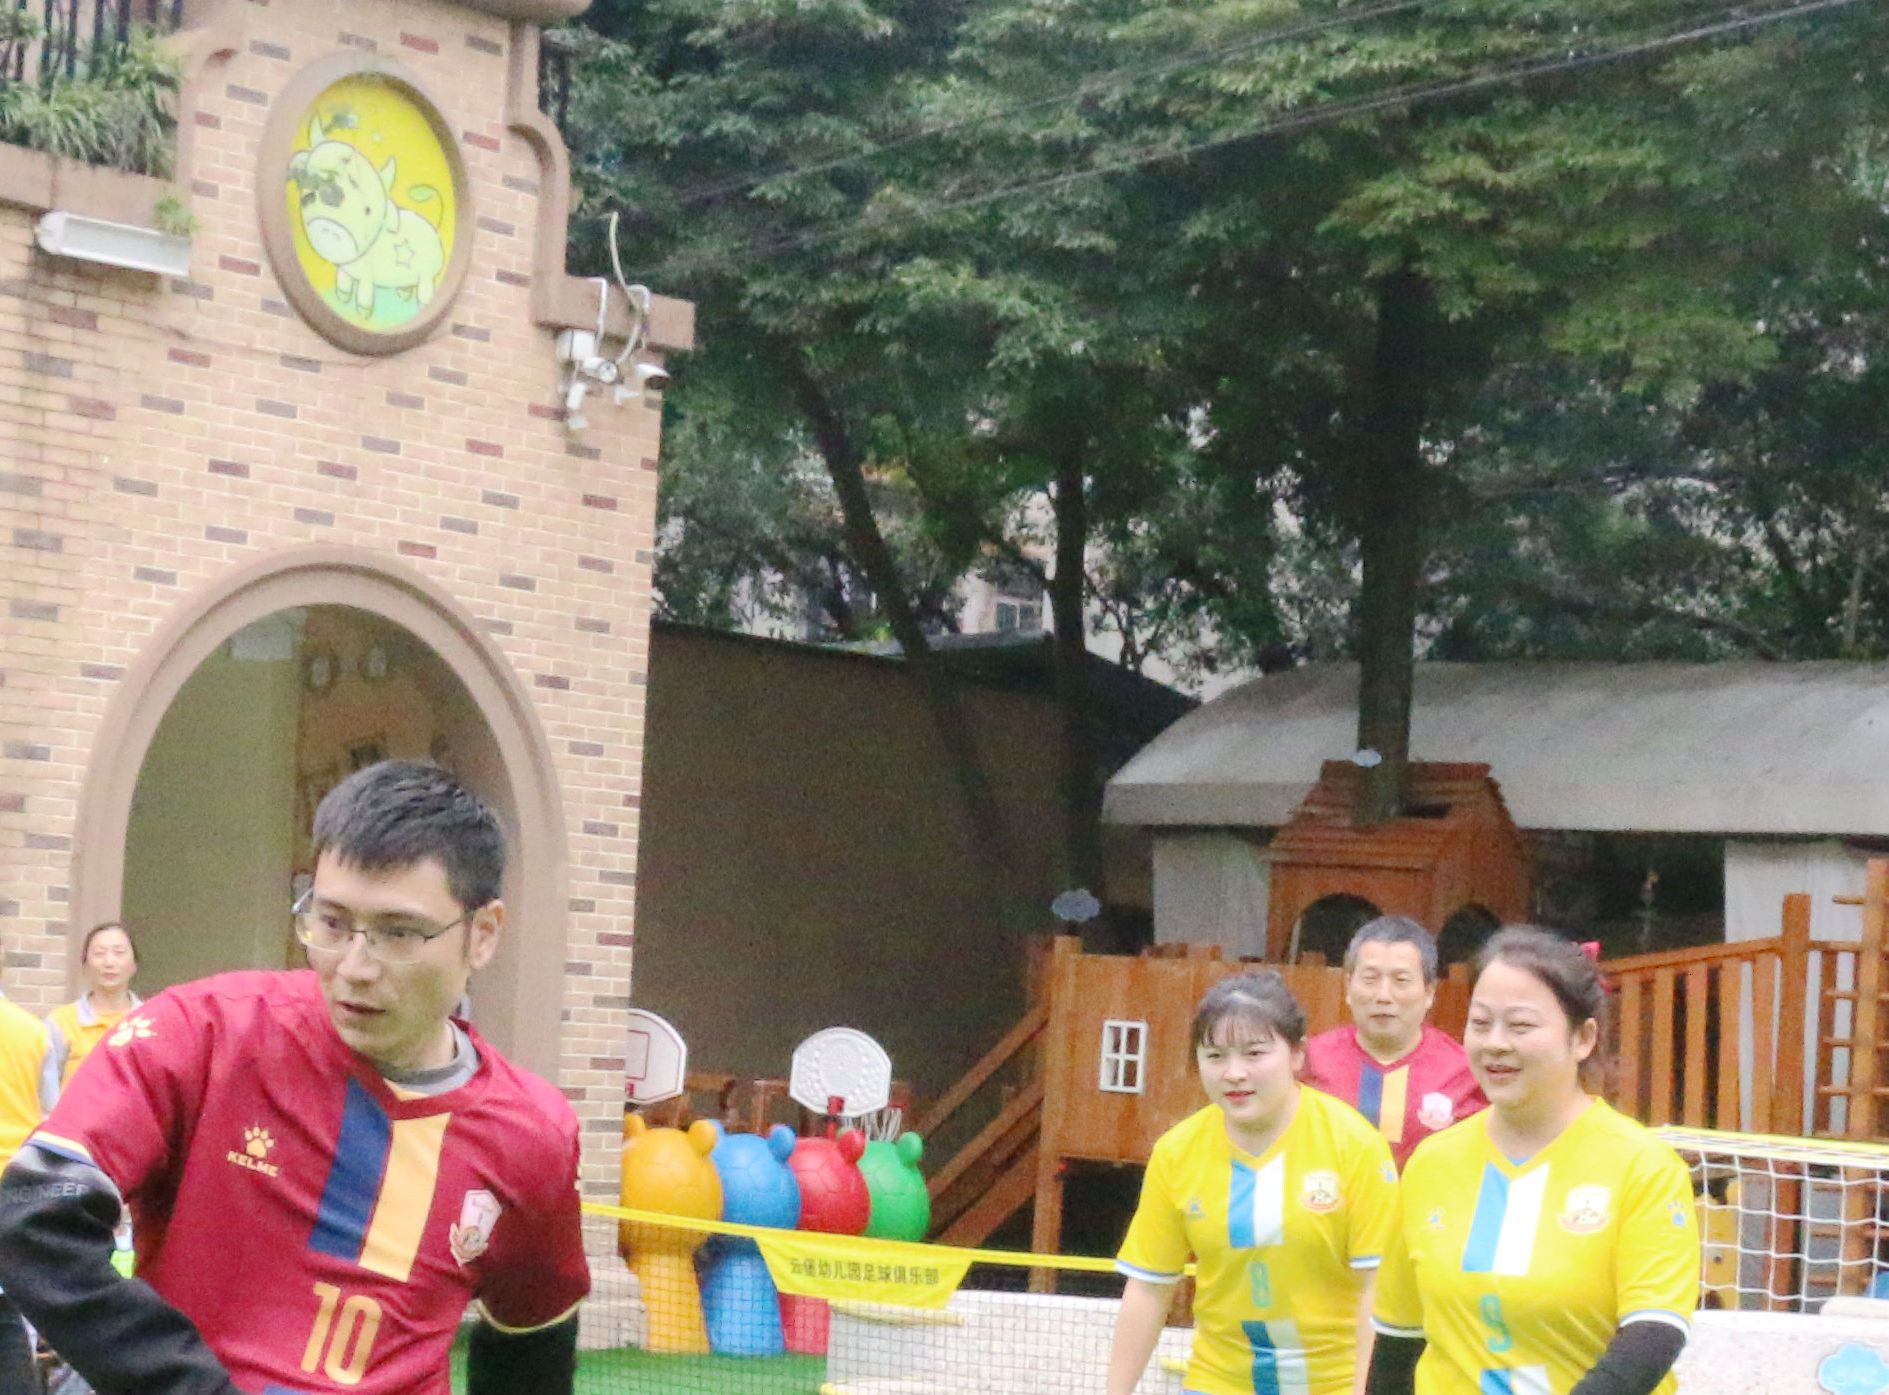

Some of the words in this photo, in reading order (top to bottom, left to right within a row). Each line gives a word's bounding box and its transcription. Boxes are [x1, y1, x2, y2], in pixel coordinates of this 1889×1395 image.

[226, 1150, 279, 1178] KELME
[301, 1280, 383, 1385] 10
[1481, 1293, 1513, 1353] 9
